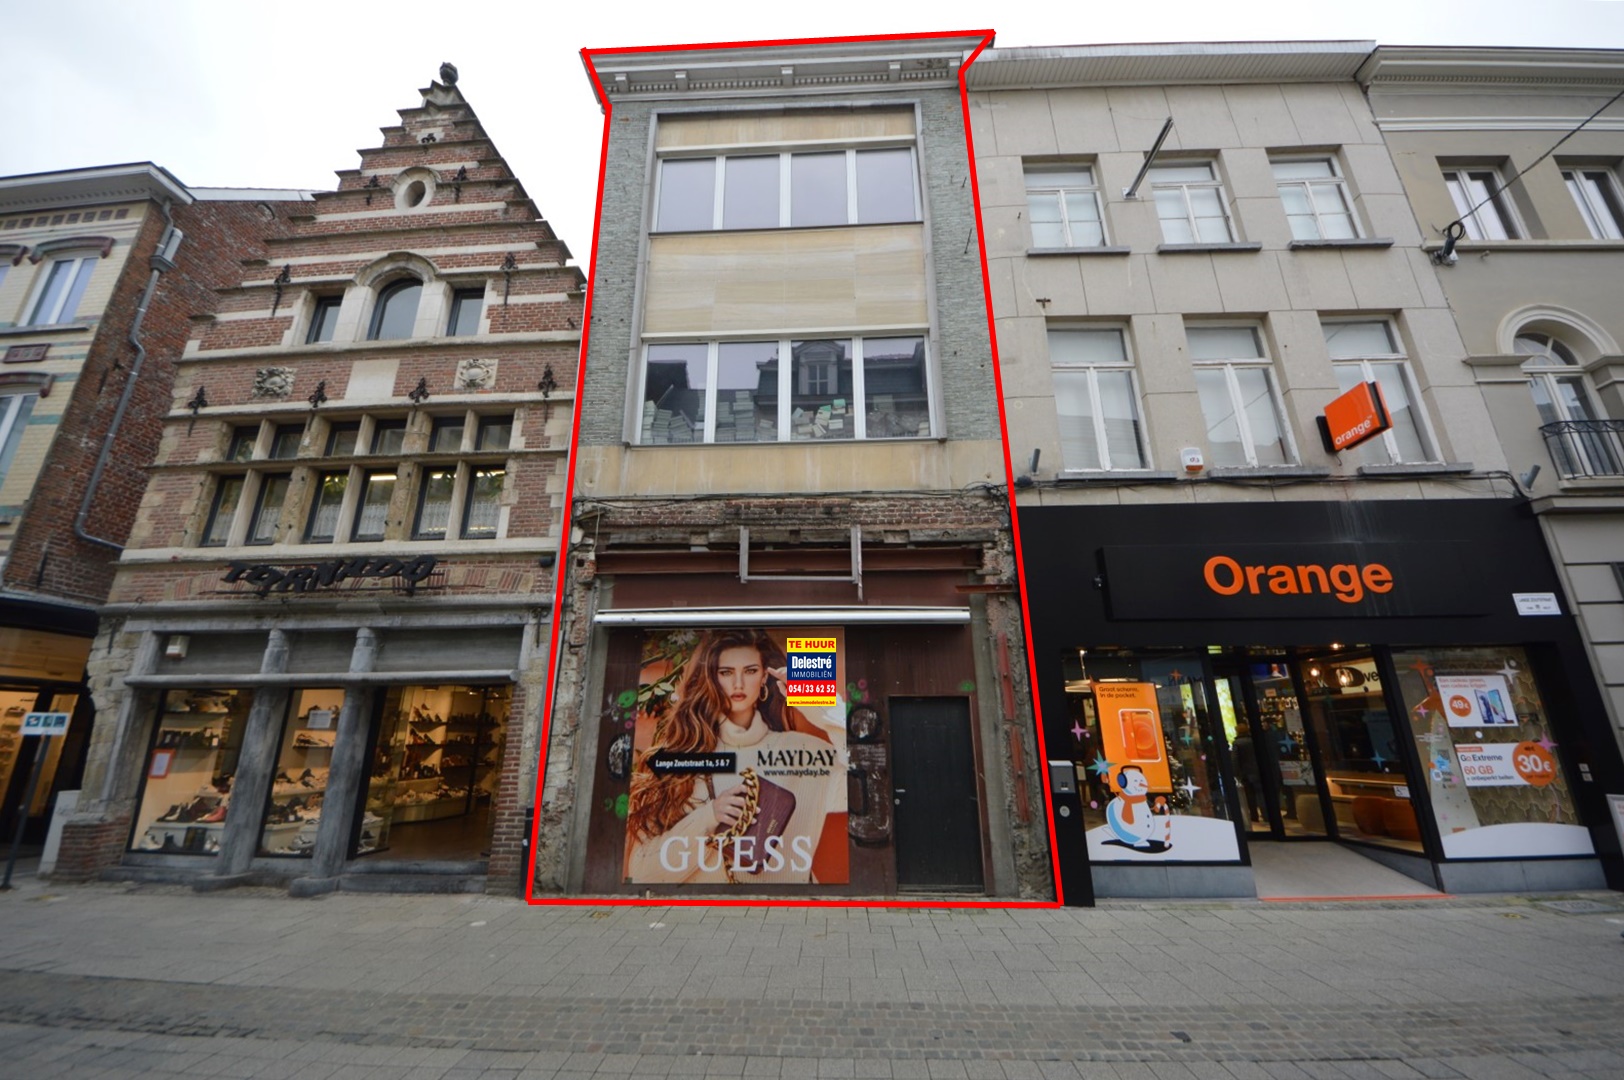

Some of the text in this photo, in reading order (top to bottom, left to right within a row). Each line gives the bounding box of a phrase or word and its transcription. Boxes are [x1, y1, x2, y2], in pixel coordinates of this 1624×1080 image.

[1335, 418, 1371, 445] orange
[222, 555, 438, 594] TORNADO
[1203, 556, 1394, 604] Orange
[655, 759, 730, 769] Lange Zoutstraat 1a, 5 & 7
[757, 750, 837, 767] MAYDAY
[1460, 754, 1503, 762] Go Extreme
[1517, 754, 1552, 773] 30€
[763, 768, 830, 778] www.mayday.be
[1464, 765, 1476, 775] 60
[1477, 765, 1493, 775] GB
[659, 836, 812, 873] GUESS
